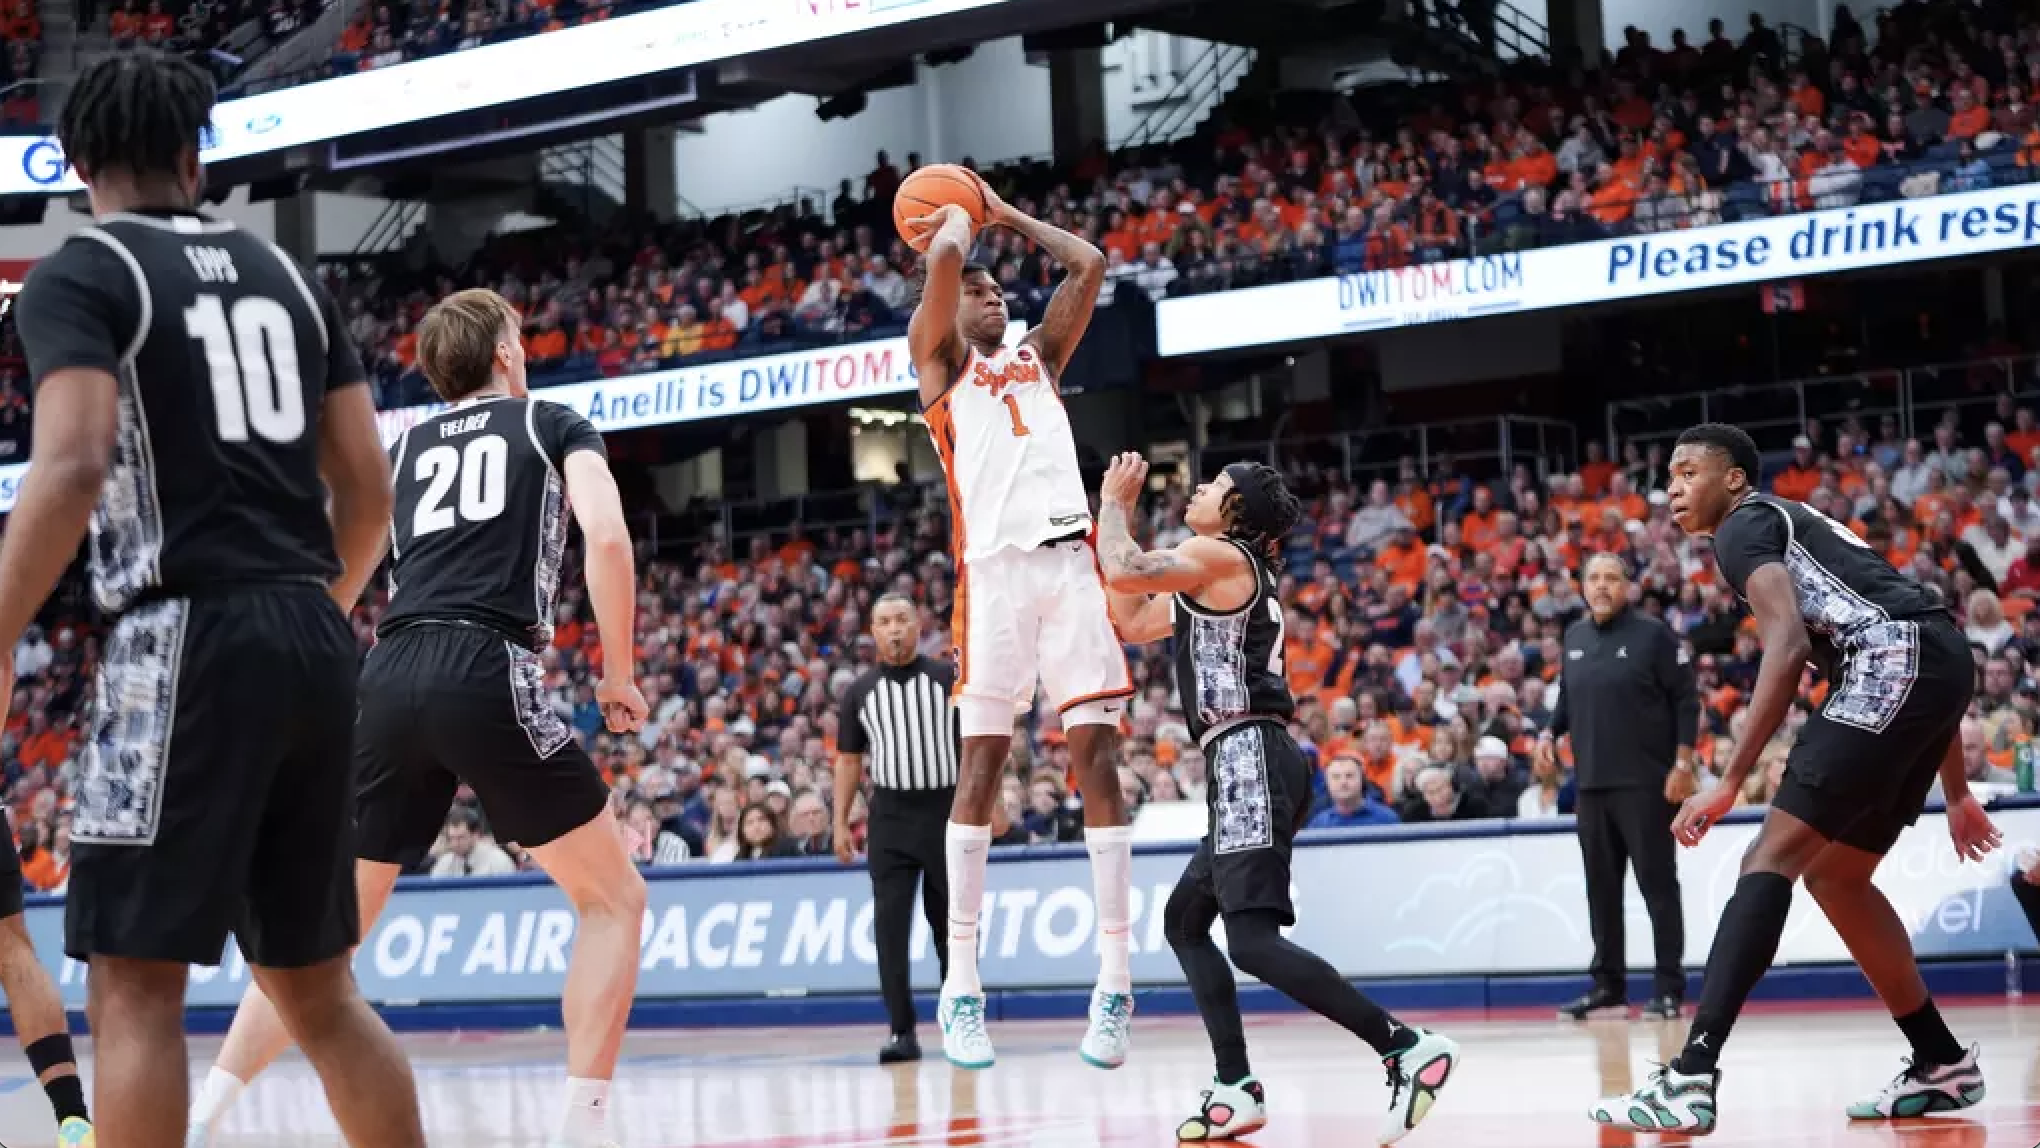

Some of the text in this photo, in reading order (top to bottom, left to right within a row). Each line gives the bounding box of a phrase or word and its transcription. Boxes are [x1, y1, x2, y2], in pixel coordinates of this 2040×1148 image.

[1608, 234, 1771, 283] Please
[1789, 206, 1922, 261] drink
[184, 293, 306, 443] 10
[588, 376, 685, 422] Anelli
[697, 374, 725, 415] is
[1002, 393, 1031, 436] 1
[413, 434, 508, 538] 20
[373, 912, 460, 980] OF
